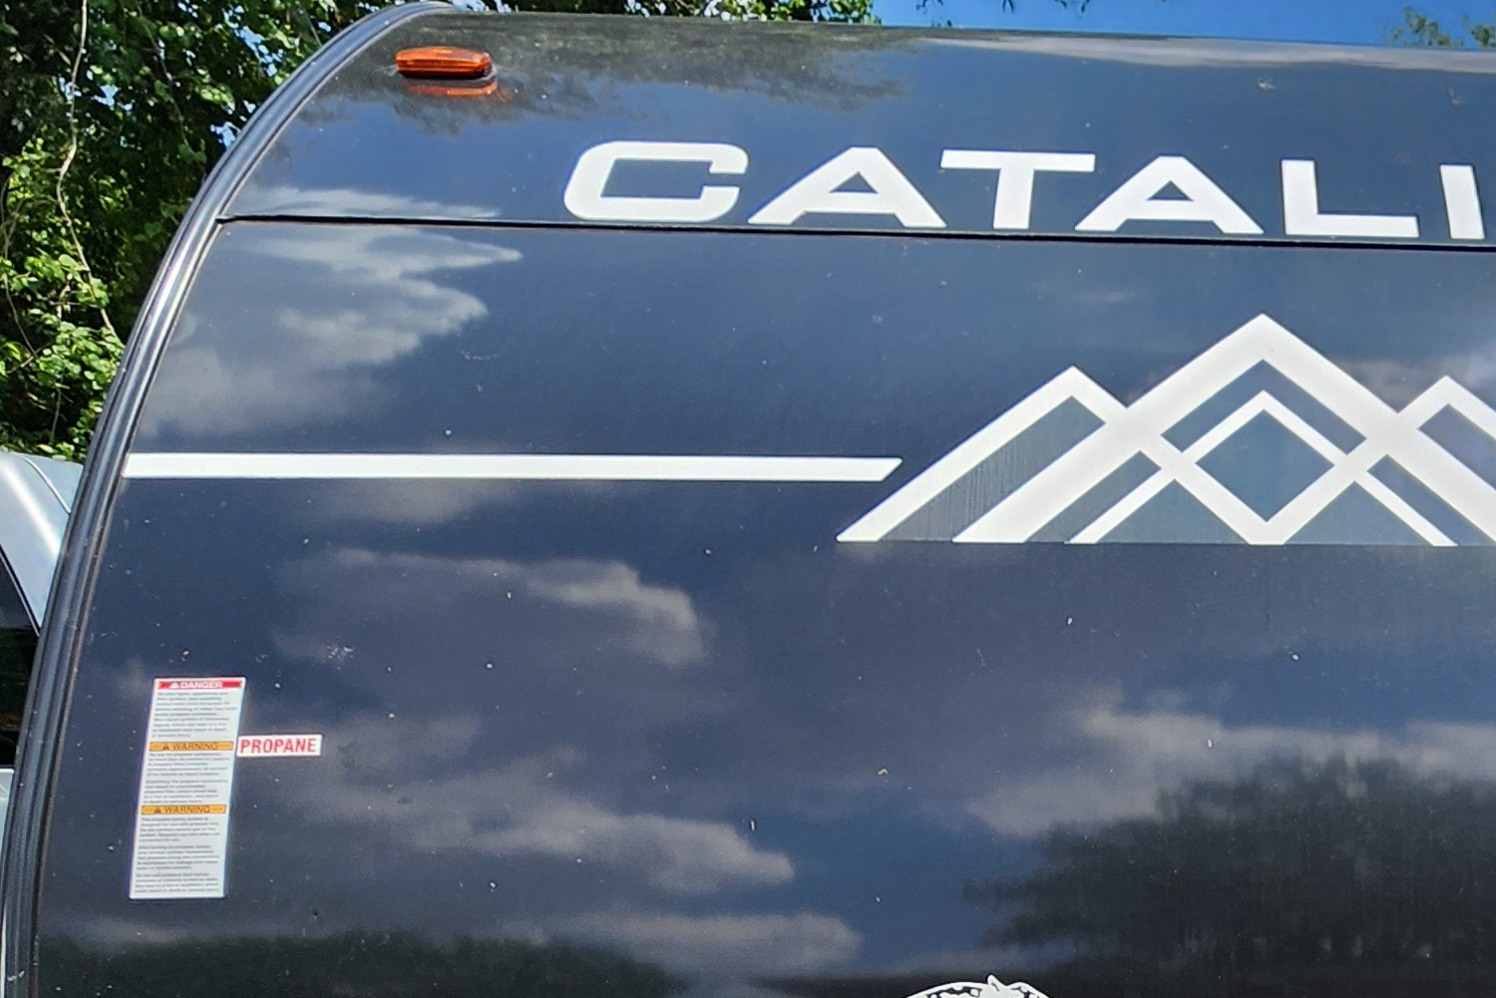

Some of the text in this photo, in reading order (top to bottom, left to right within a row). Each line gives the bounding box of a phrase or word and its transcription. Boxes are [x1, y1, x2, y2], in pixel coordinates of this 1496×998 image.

[180, 680, 224, 689] DANGER
[172, 742, 218, 751] WARNING
[240, 737, 317, 754] PROPANE
[164, 805, 210, 814] WARNING
